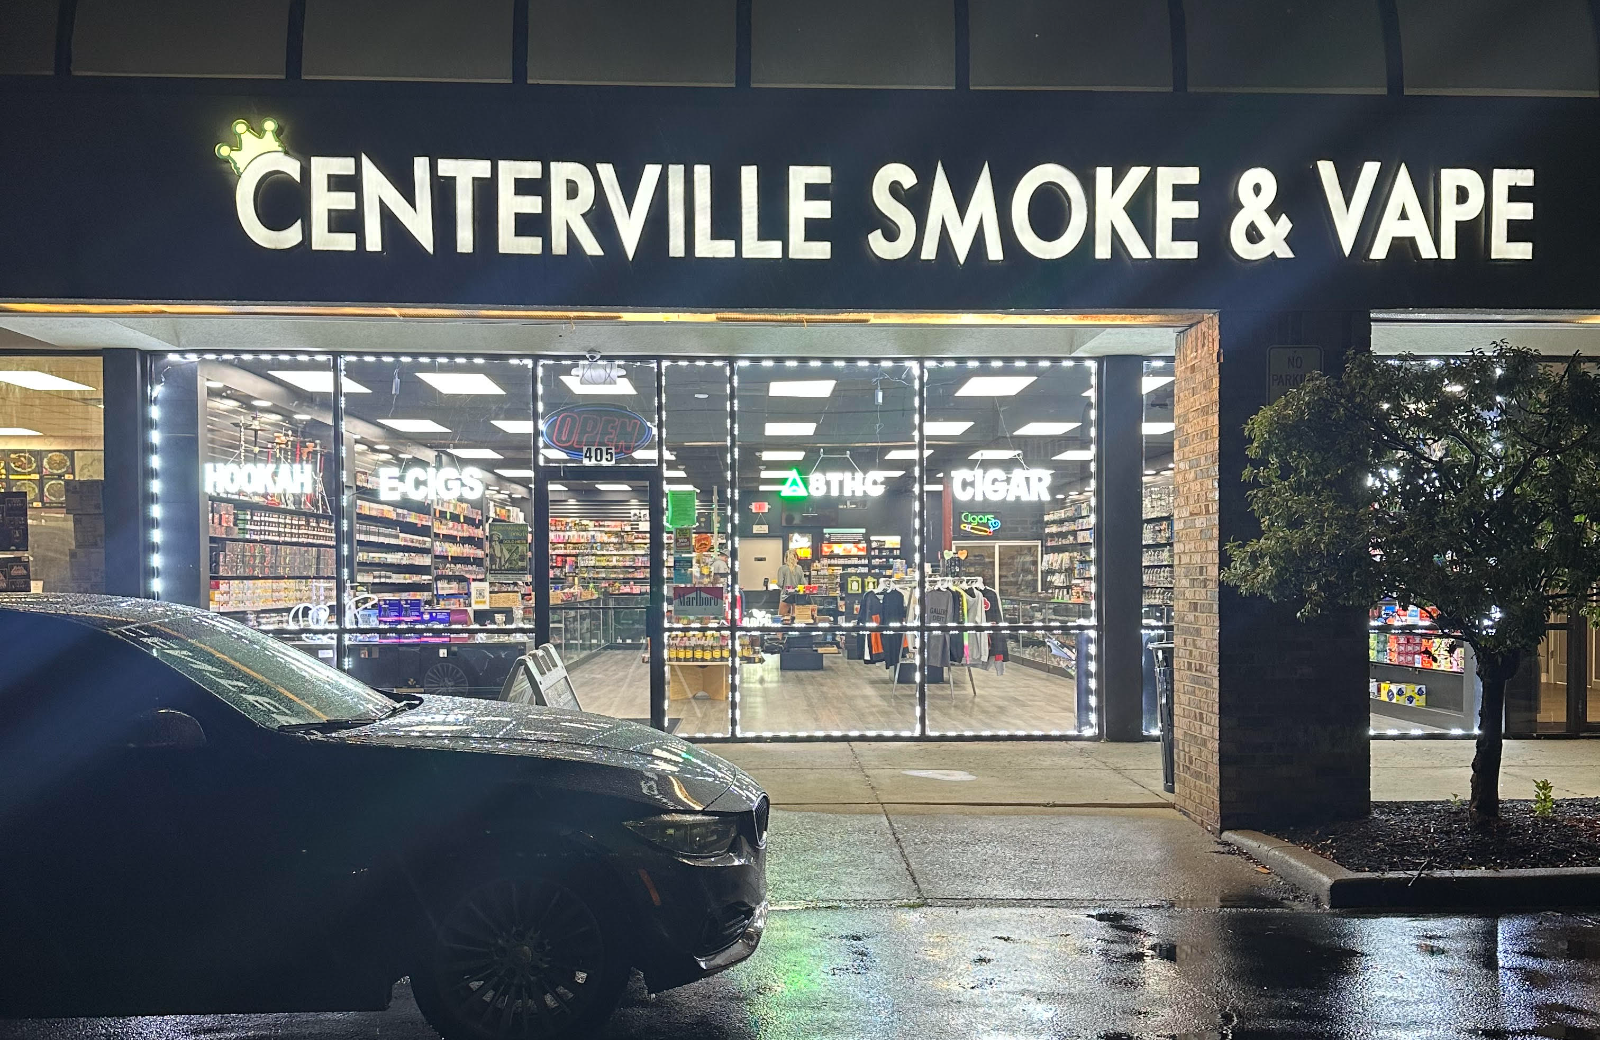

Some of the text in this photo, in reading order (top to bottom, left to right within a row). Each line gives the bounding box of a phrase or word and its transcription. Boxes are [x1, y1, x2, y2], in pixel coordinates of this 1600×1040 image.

[235, 150, 1535, 266] CENTERVILLE SMOKE & VAPE
[1287, 355, 1303, 369] NO
[1271, 373, 1307, 387] PARKI
[553, 412, 640, 453] OPEN
[584, 448, 614, 463] 405
[205, 464, 312, 494] HOOKAH
[379, 467, 485, 500] E-CIGS
[952, 469, 1051, 501] CIGAR
[961, 511, 995, 526] Cigars
[677, 590, 719, 607] Marlboro
